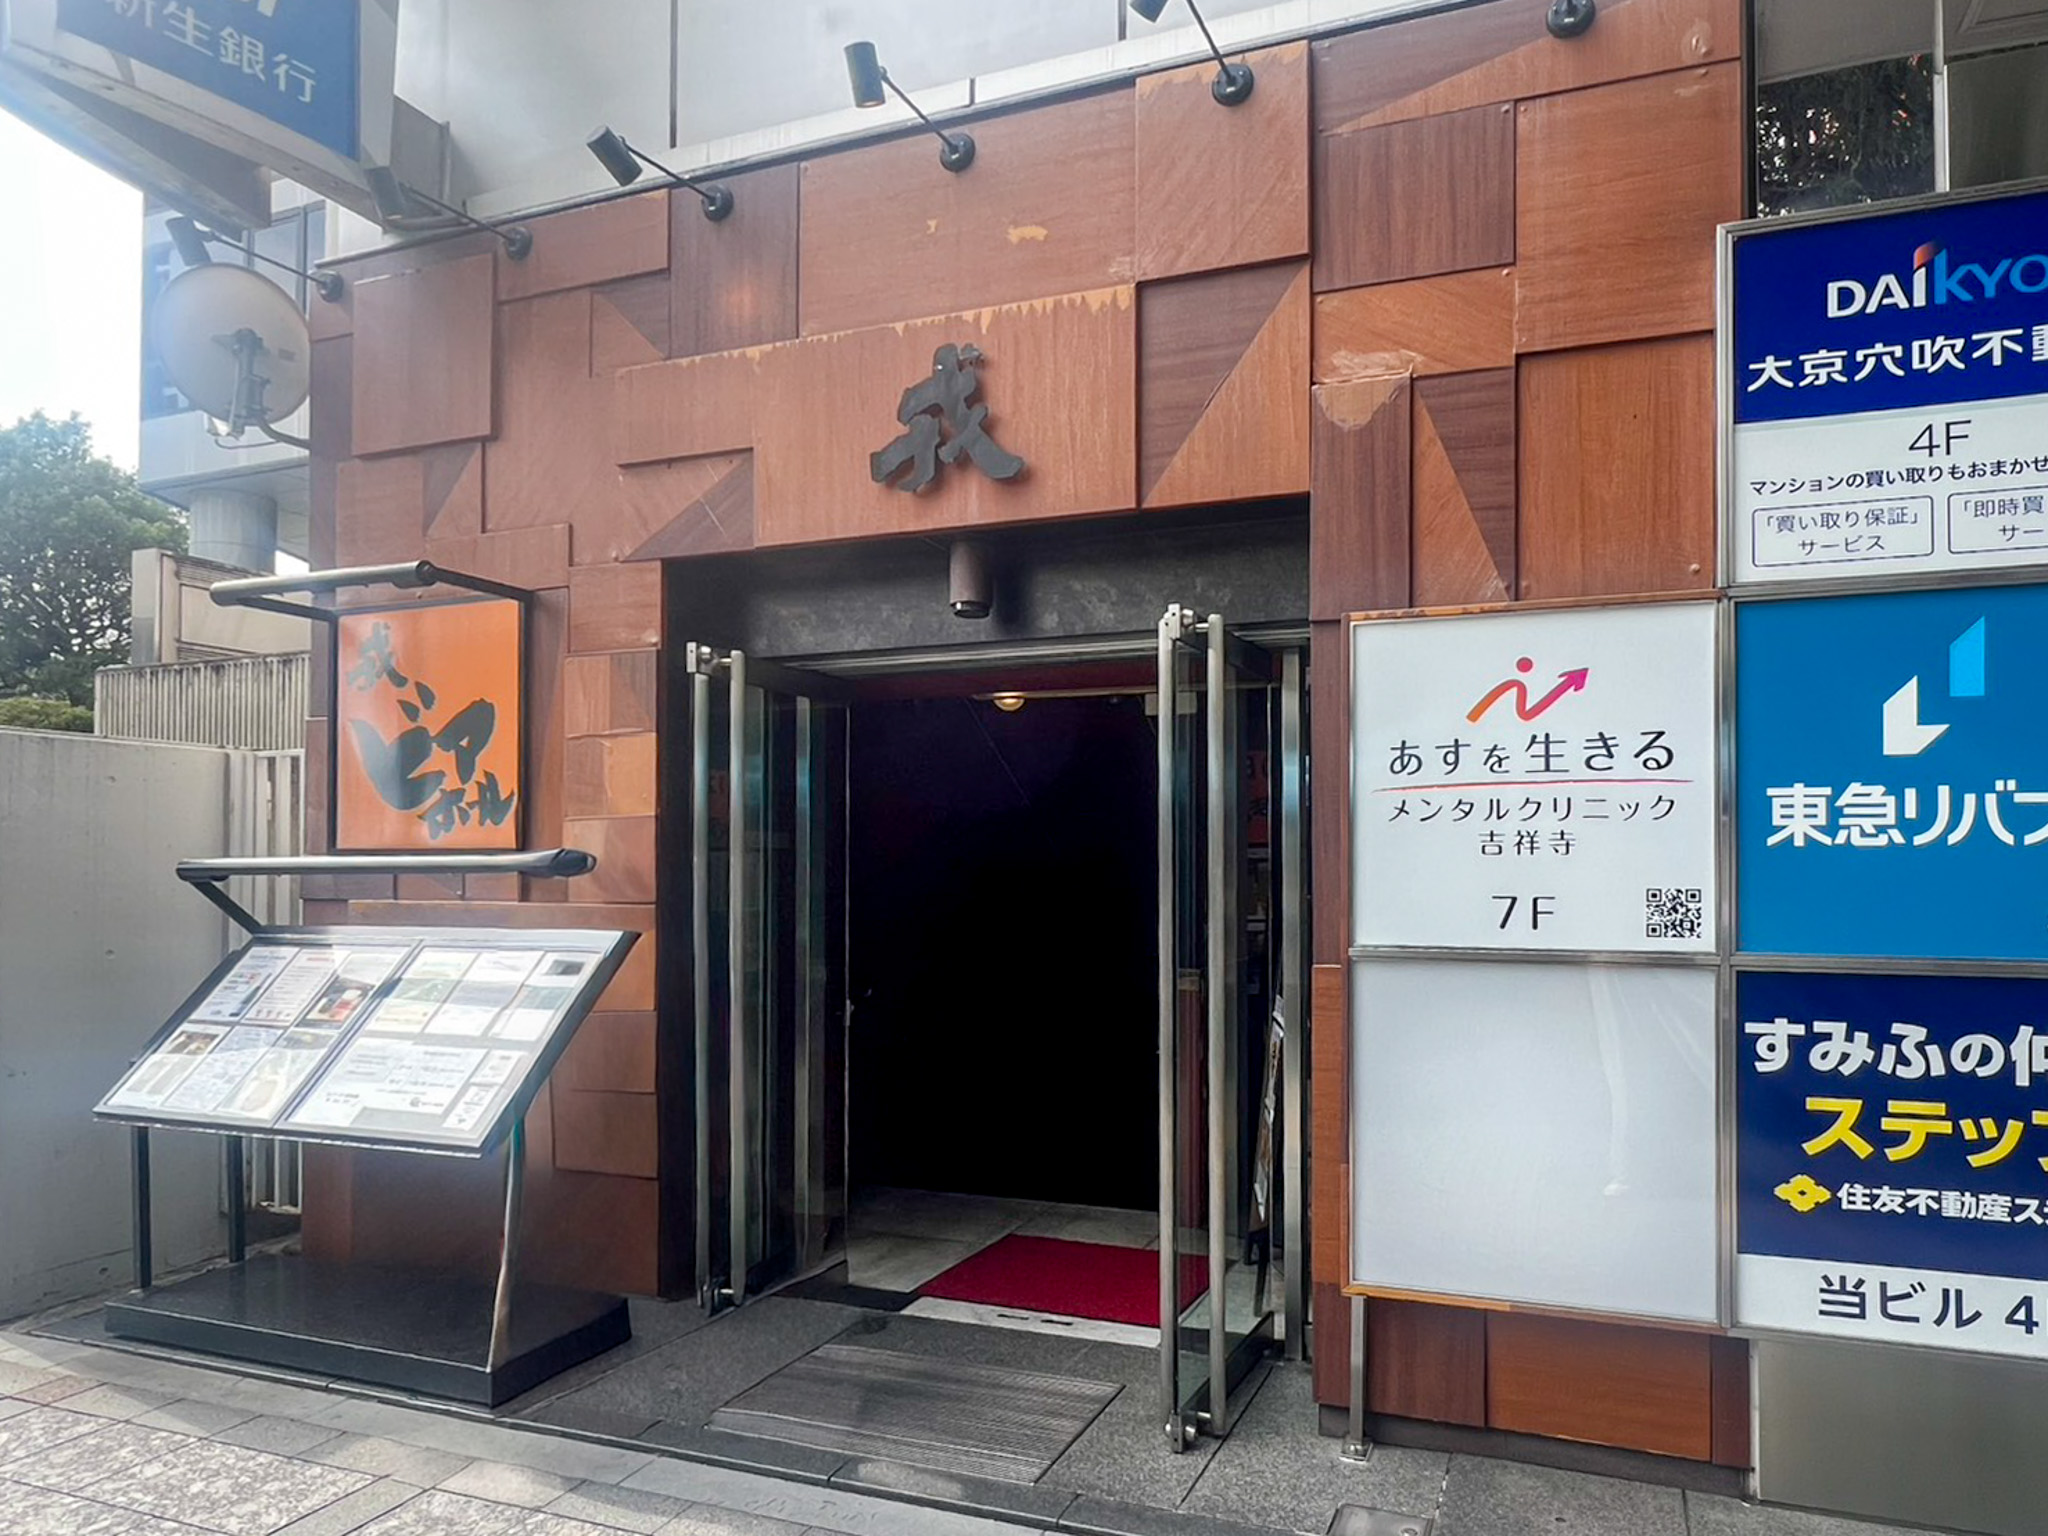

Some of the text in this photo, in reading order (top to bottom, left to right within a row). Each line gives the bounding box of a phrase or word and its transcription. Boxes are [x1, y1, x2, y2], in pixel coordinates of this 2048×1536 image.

[1908, 419, 1972, 458] 4F
[1798, 533, 1885, 557] サービス
[1388, 730, 1675, 776] あすを生きる
[1388, 794, 1676, 823] メンタルクリニック
[1478, 829, 1577, 857] 吉祥寺
[1491, 895, 1557, 931] 7F
[1801, 1096, 2048, 1173] ステッ
[1837, 1182, 2048, 1226] 住友不動産ス
[1818, 1274, 1983, 1330] 当ビル
